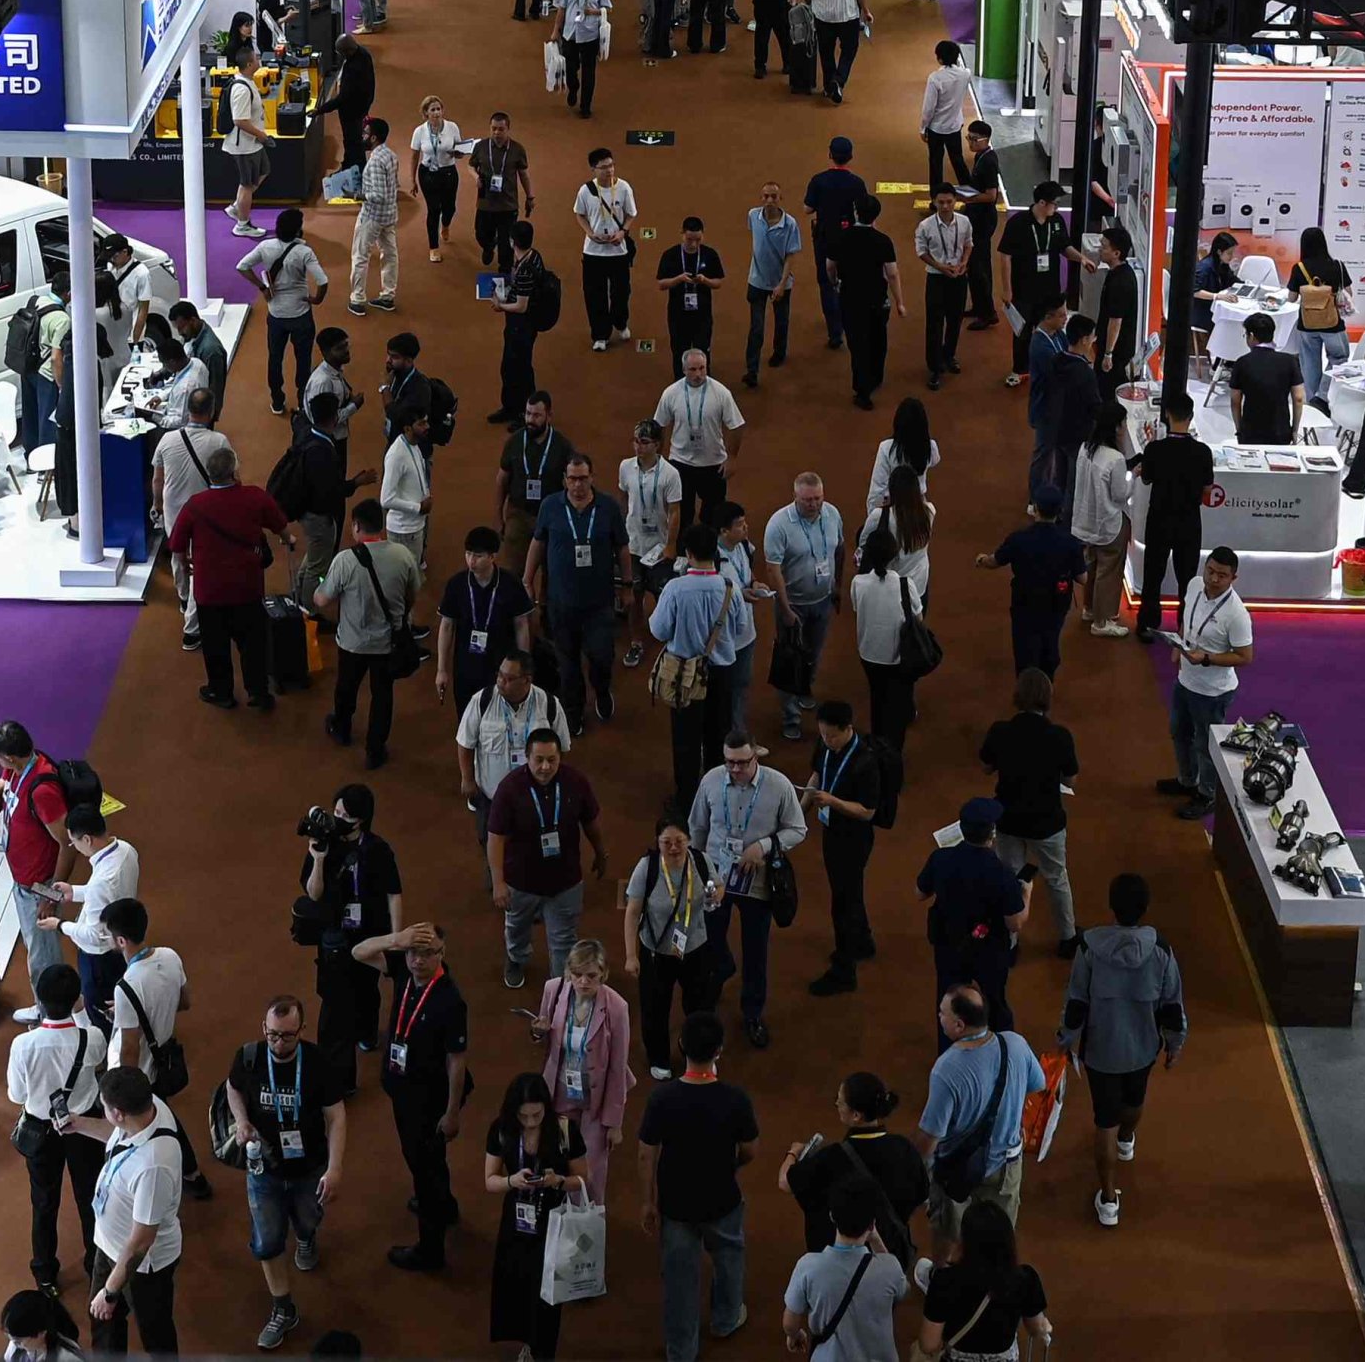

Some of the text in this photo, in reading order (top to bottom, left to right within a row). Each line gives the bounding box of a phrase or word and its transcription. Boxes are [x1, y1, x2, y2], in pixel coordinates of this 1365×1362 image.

[1270, 103, 1303, 112] Power.
[1251, 115, 1316, 124] & Affordable.
[1216, 131, 1237, 139] power
[1249, 131, 1278, 139] everyday
[1280, 130, 1305, 138] comfort
